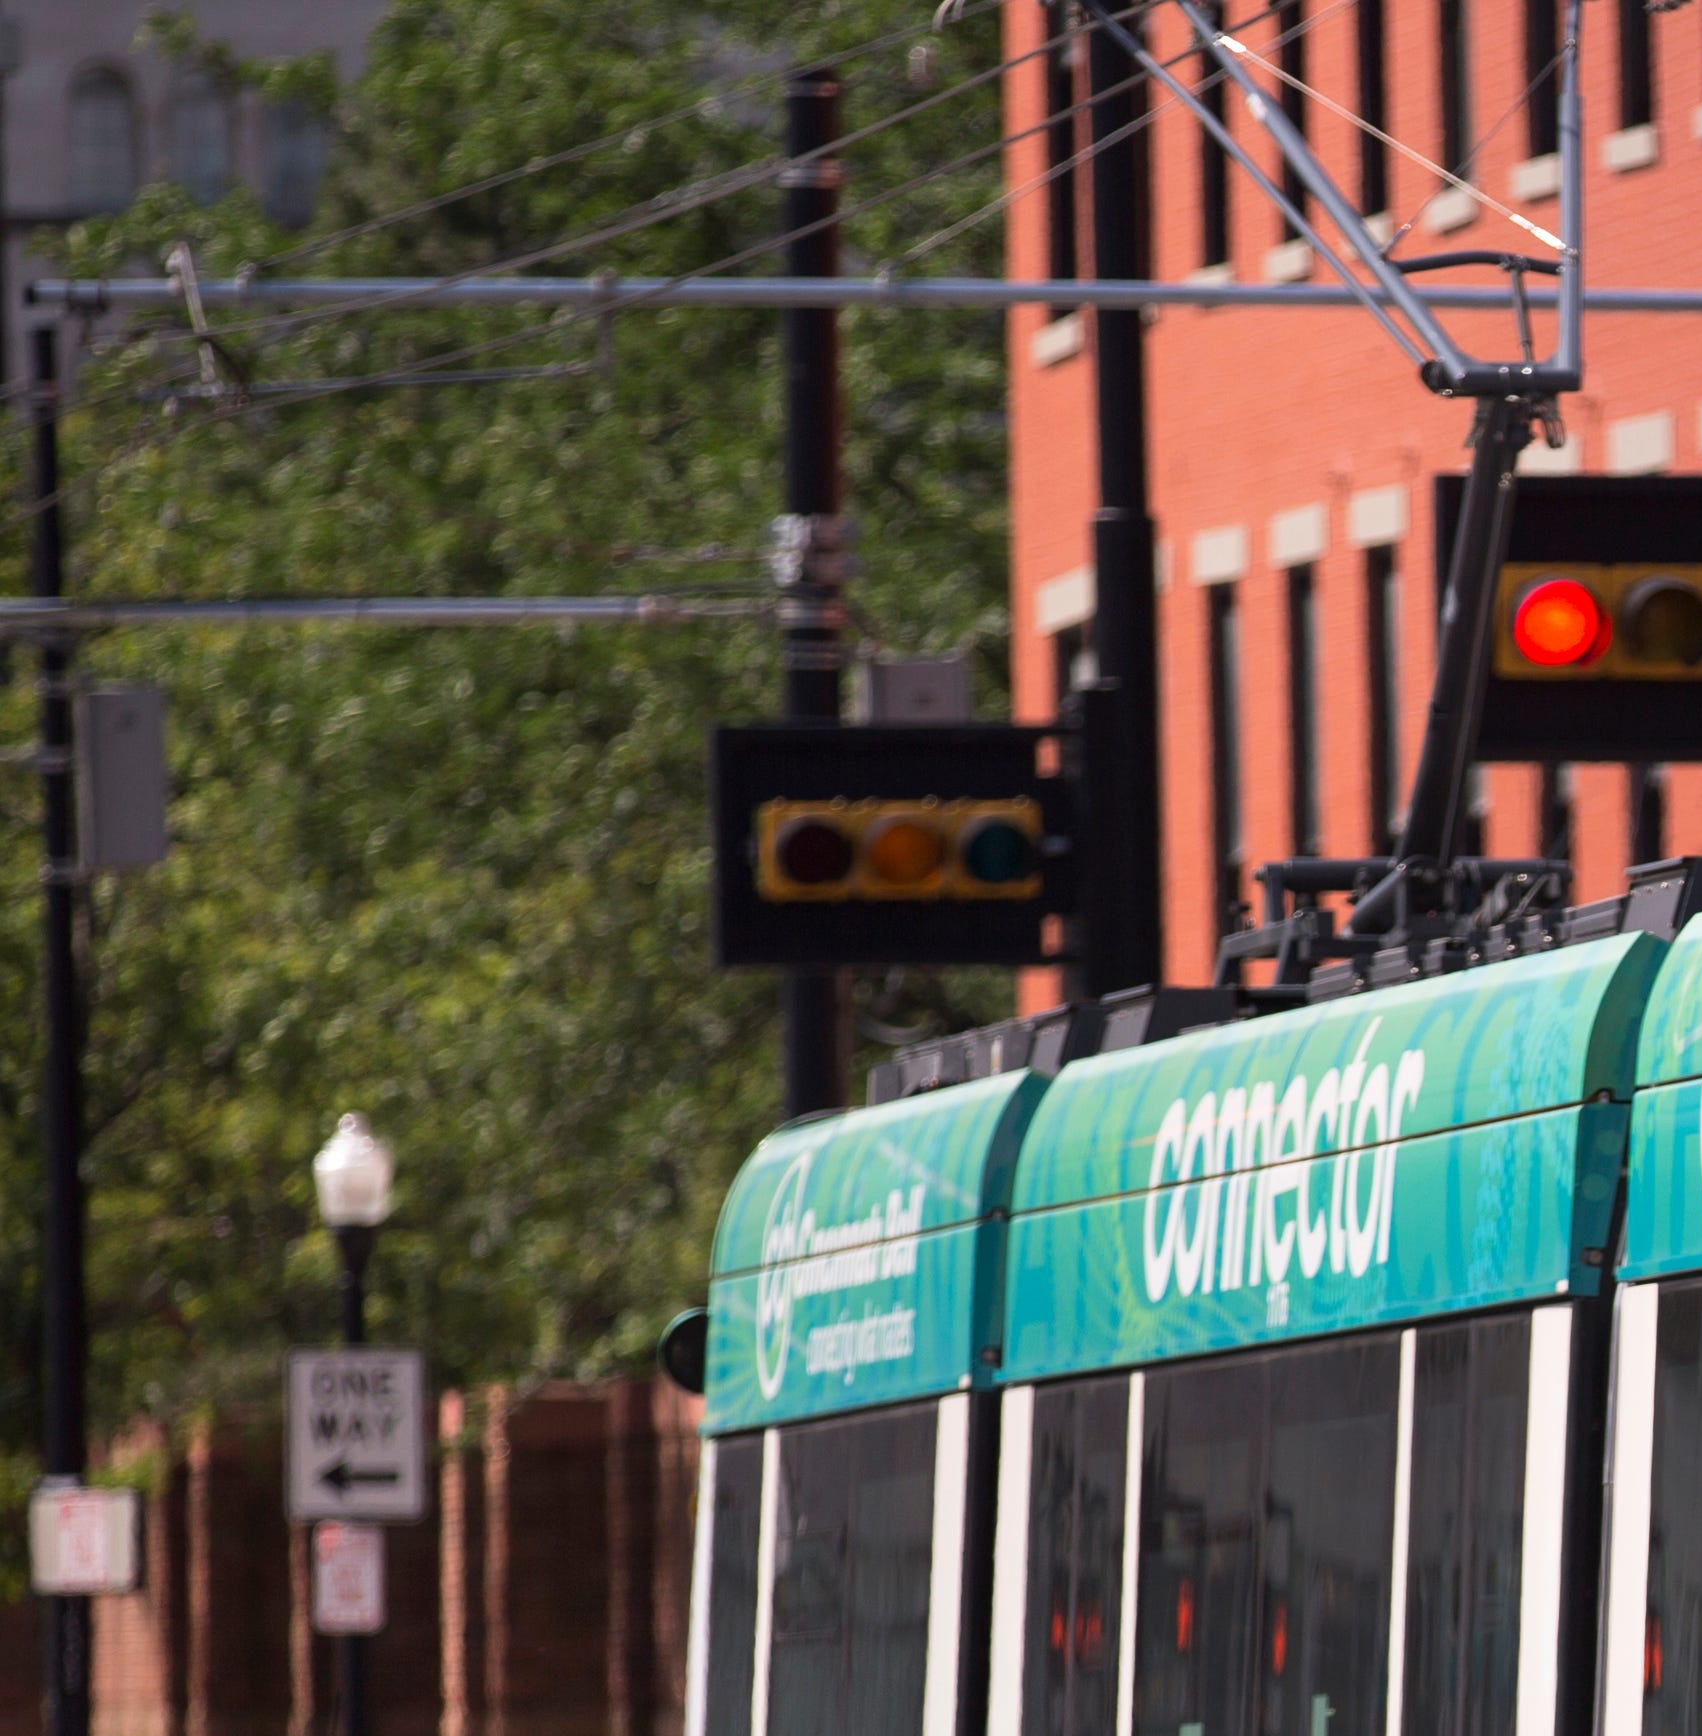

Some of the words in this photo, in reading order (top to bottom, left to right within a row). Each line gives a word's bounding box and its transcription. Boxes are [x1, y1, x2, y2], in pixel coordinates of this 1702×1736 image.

[1144, 1016, 1424, 1302] connector
[312, 1367, 394, 1397] ONE
[311, 1411, 399, 1444] WAY
